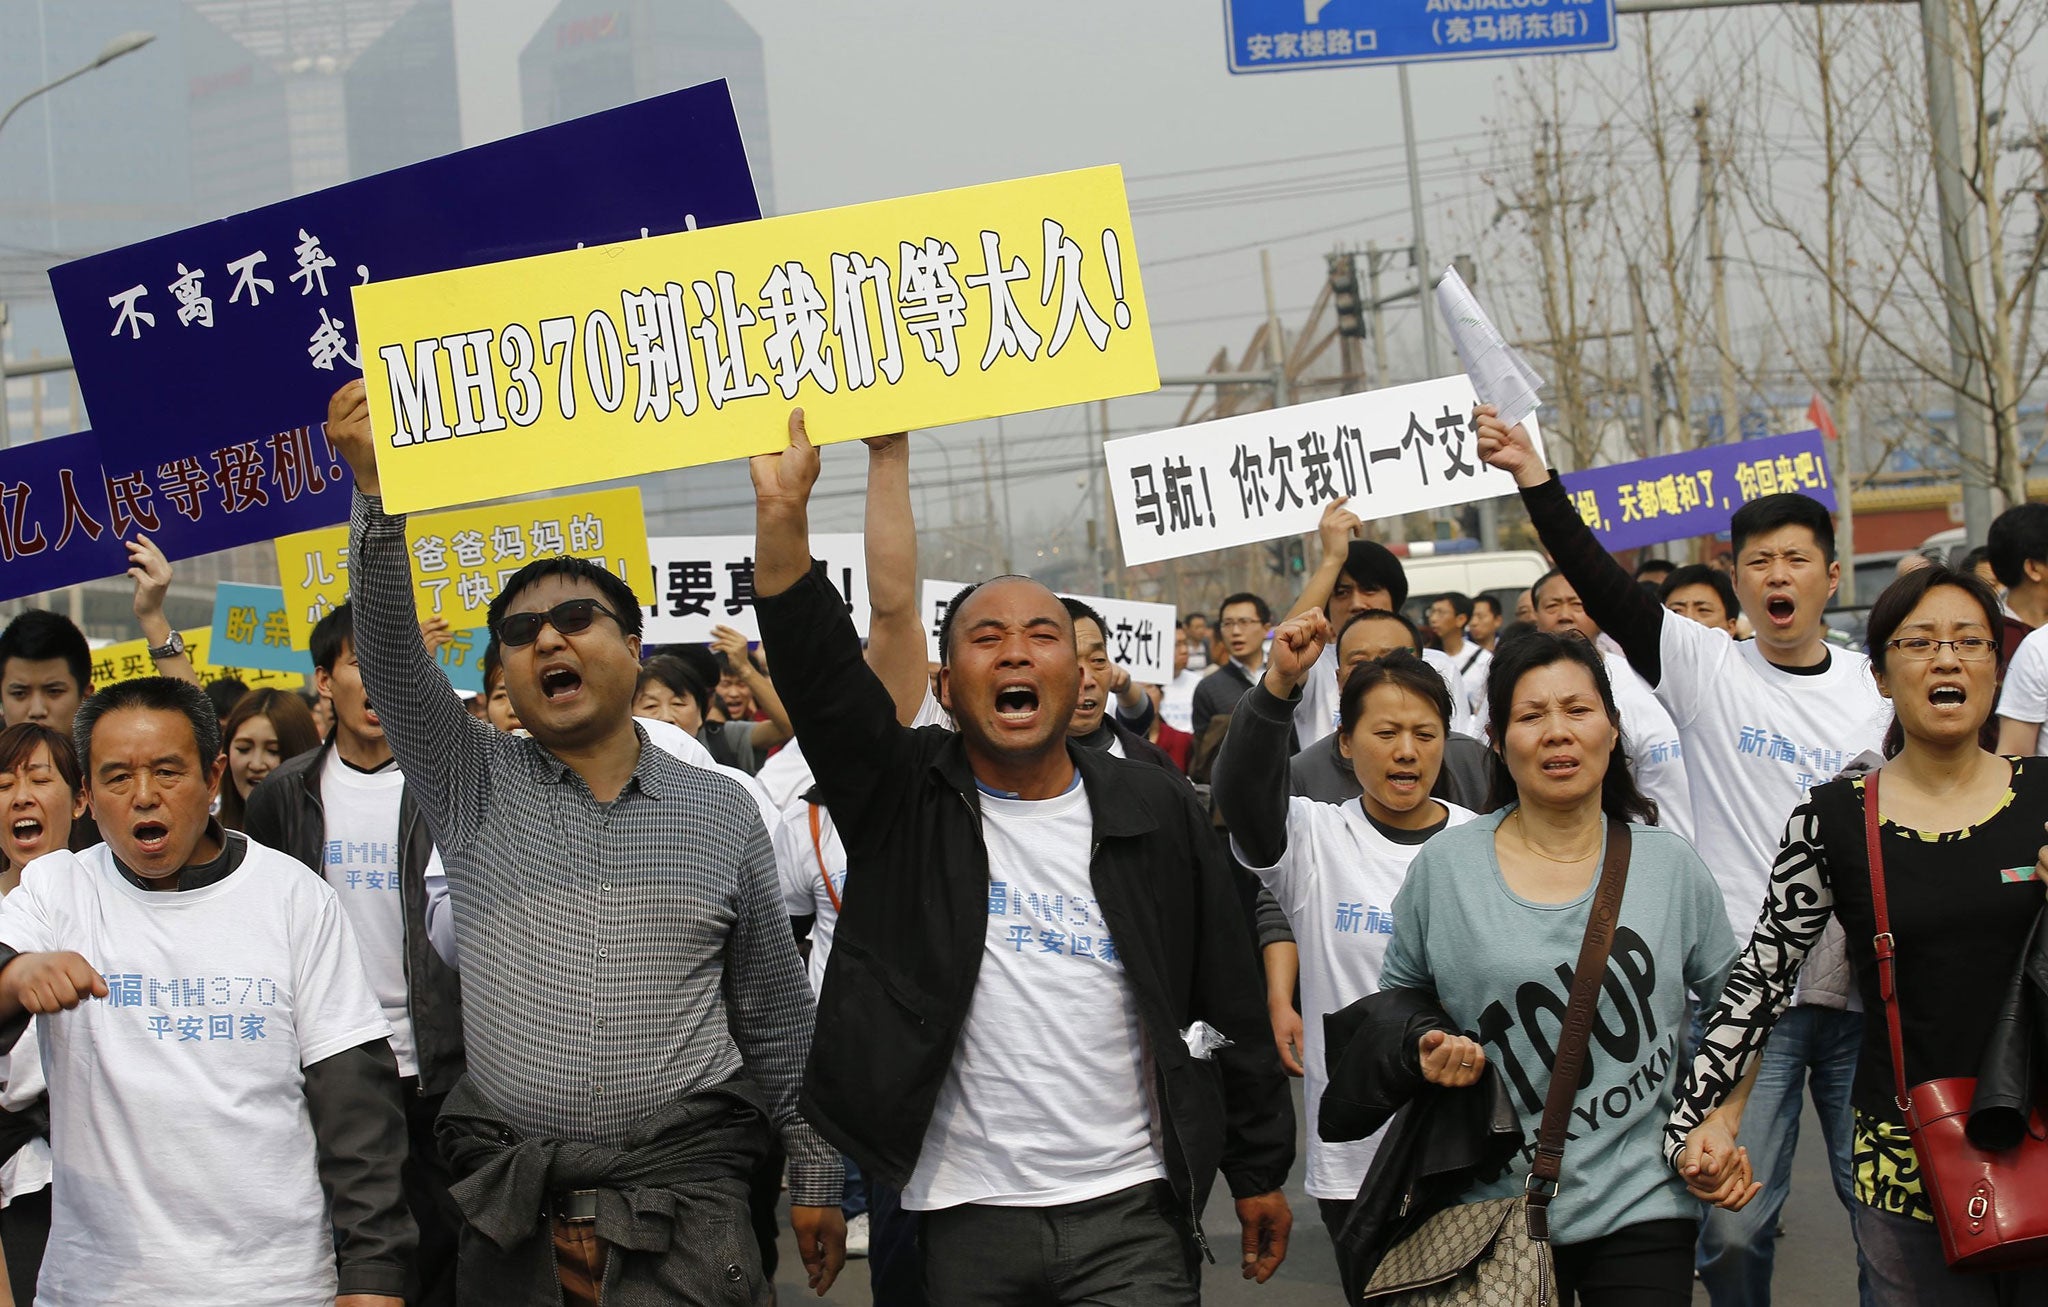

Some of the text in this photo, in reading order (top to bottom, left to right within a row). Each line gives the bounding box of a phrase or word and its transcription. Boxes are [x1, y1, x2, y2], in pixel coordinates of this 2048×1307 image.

[1247, 29, 1378, 60] 安家楼路口
[1431, 9, 1588, 46] (亮马桥东街)
[307, 307, 363, 371] 我
[379, 218, 1132, 447] MH370别让我们等太久!
[147, 1013, 267, 1042] 平安回家
